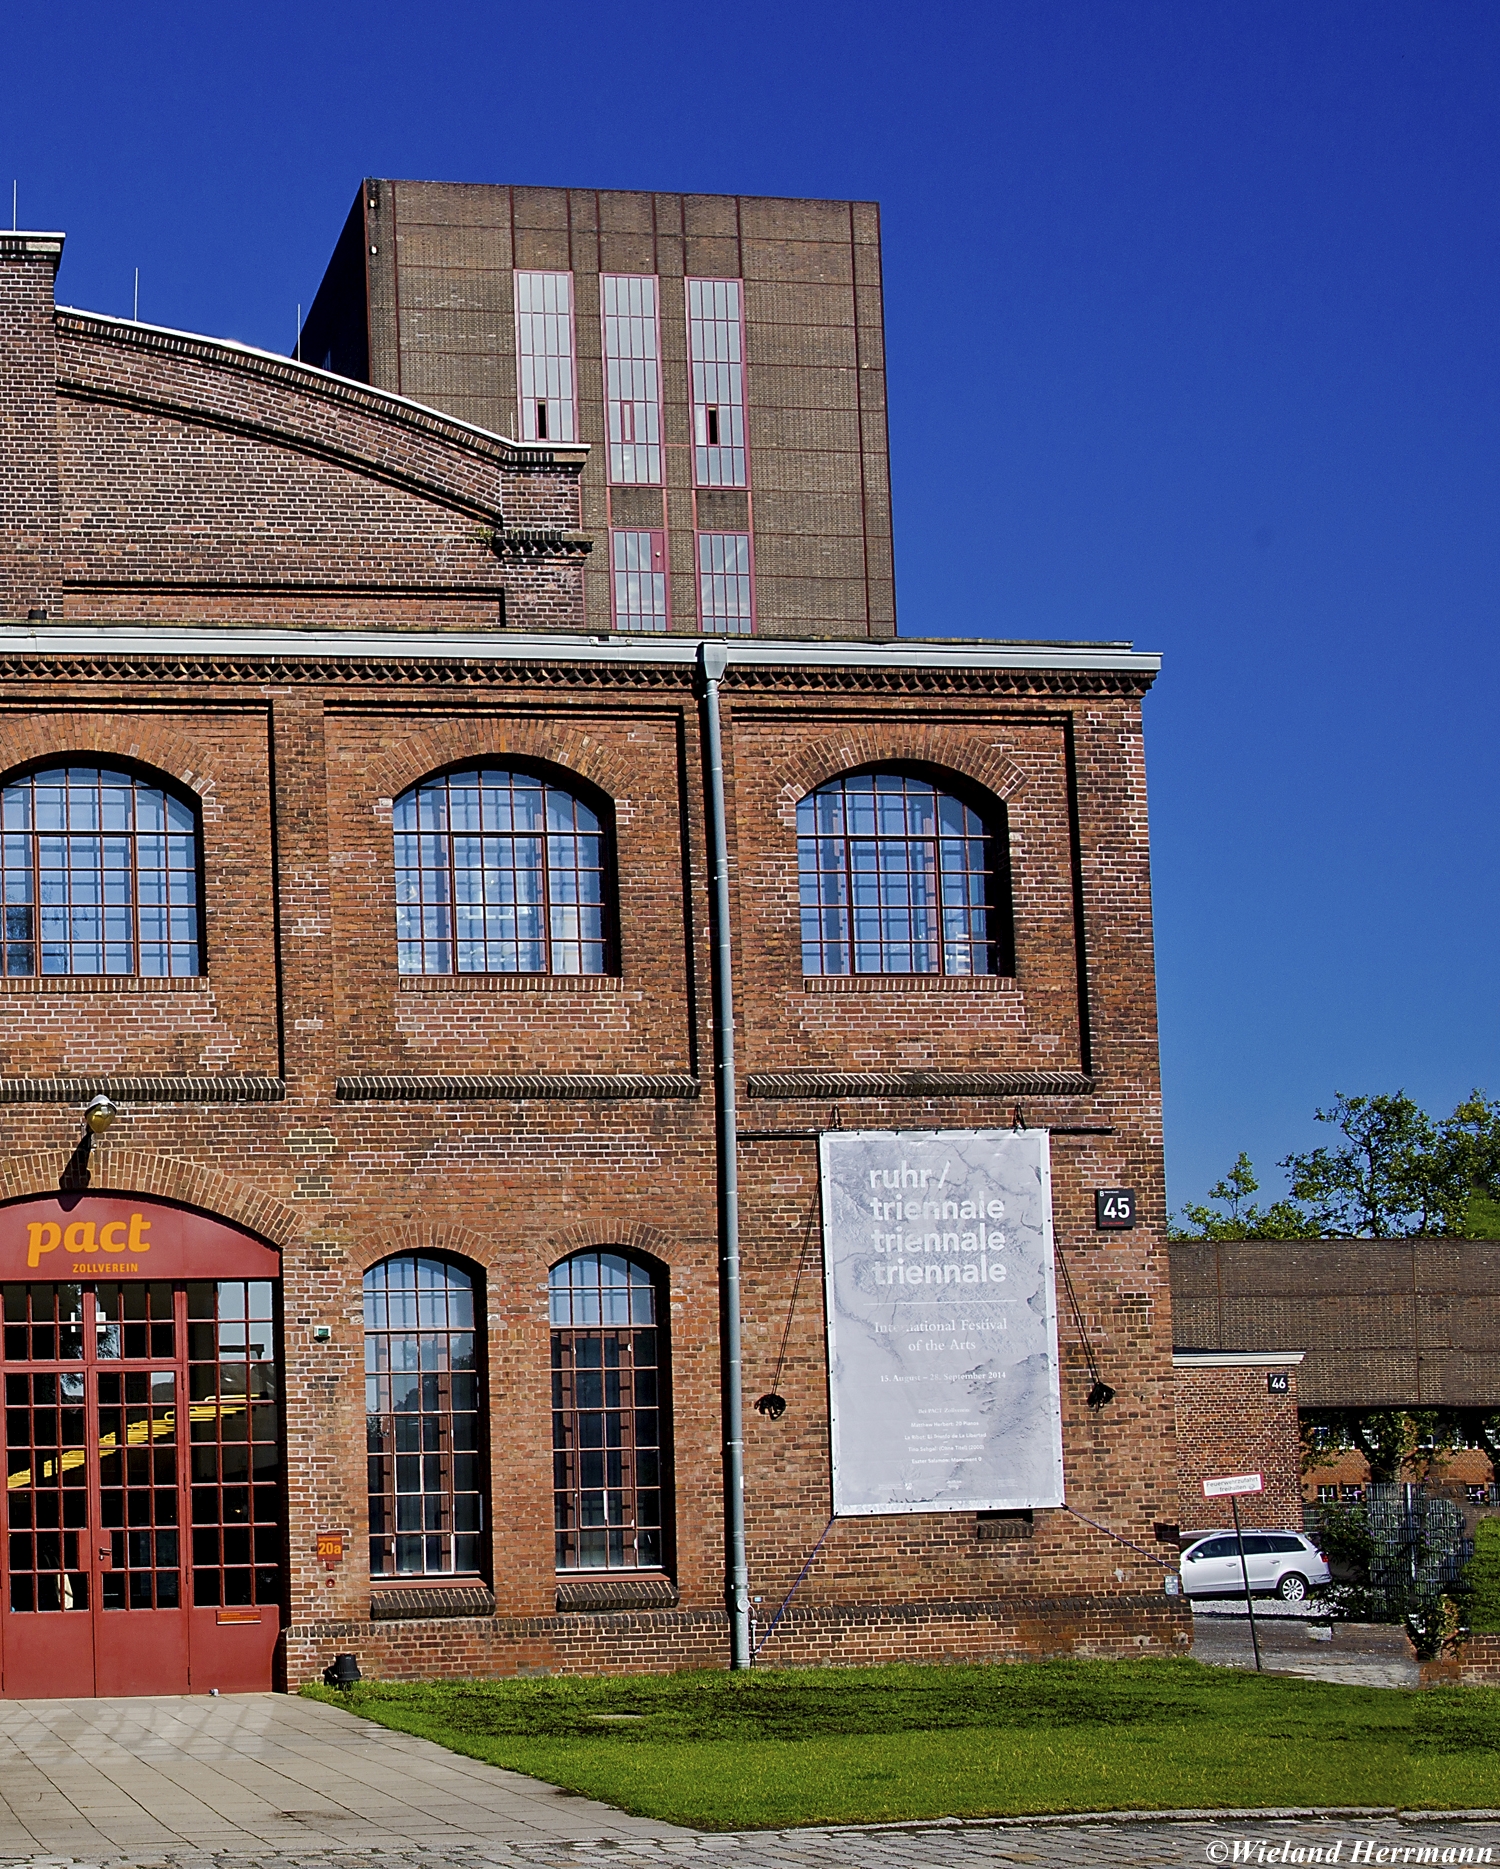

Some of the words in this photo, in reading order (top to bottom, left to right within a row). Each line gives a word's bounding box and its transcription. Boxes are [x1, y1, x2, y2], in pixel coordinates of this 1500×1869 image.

[869, 1190, 1005, 1221] triennale
[1103, 1197, 1130, 1218] 45
[26, 1213, 151, 1268] pact
[870, 1222, 1006, 1253] triennale
[72, 1263, 138, 1273] ZOLLVEREIN
[871, 1254, 1007, 1285] triennale
[961, 1318, 1008, 1331] Festival
[908, 1339, 922, 1352] of
[925, 1339, 945, 1351] the
[949, 1340, 976, 1351] Arts
[892, 1374, 921, 1383] August
[943, 1372, 985, 1382] September
[1272, 1377, 1286, 1389] 46
[1206, 1476, 1258, 1487] Feuerwehrzufahrt
[318, 1542, 342, 1555] 20a
